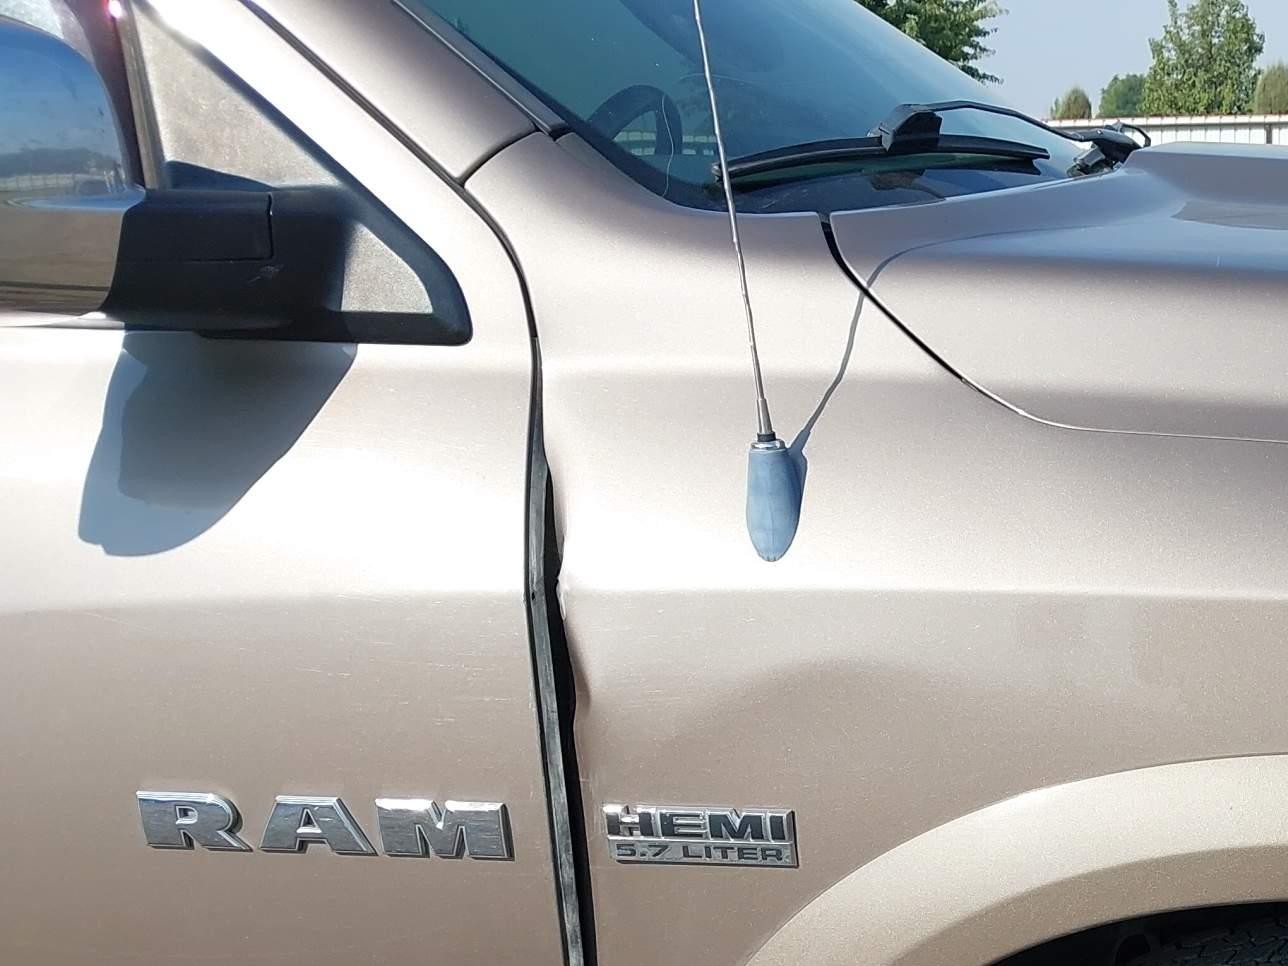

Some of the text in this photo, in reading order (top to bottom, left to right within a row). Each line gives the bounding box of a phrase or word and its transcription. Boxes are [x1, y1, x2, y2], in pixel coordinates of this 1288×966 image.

[137, 790, 514, 860] RAM
[603, 804, 795, 842] HEMI
[614, 843, 791, 862] 5.7 LITER
